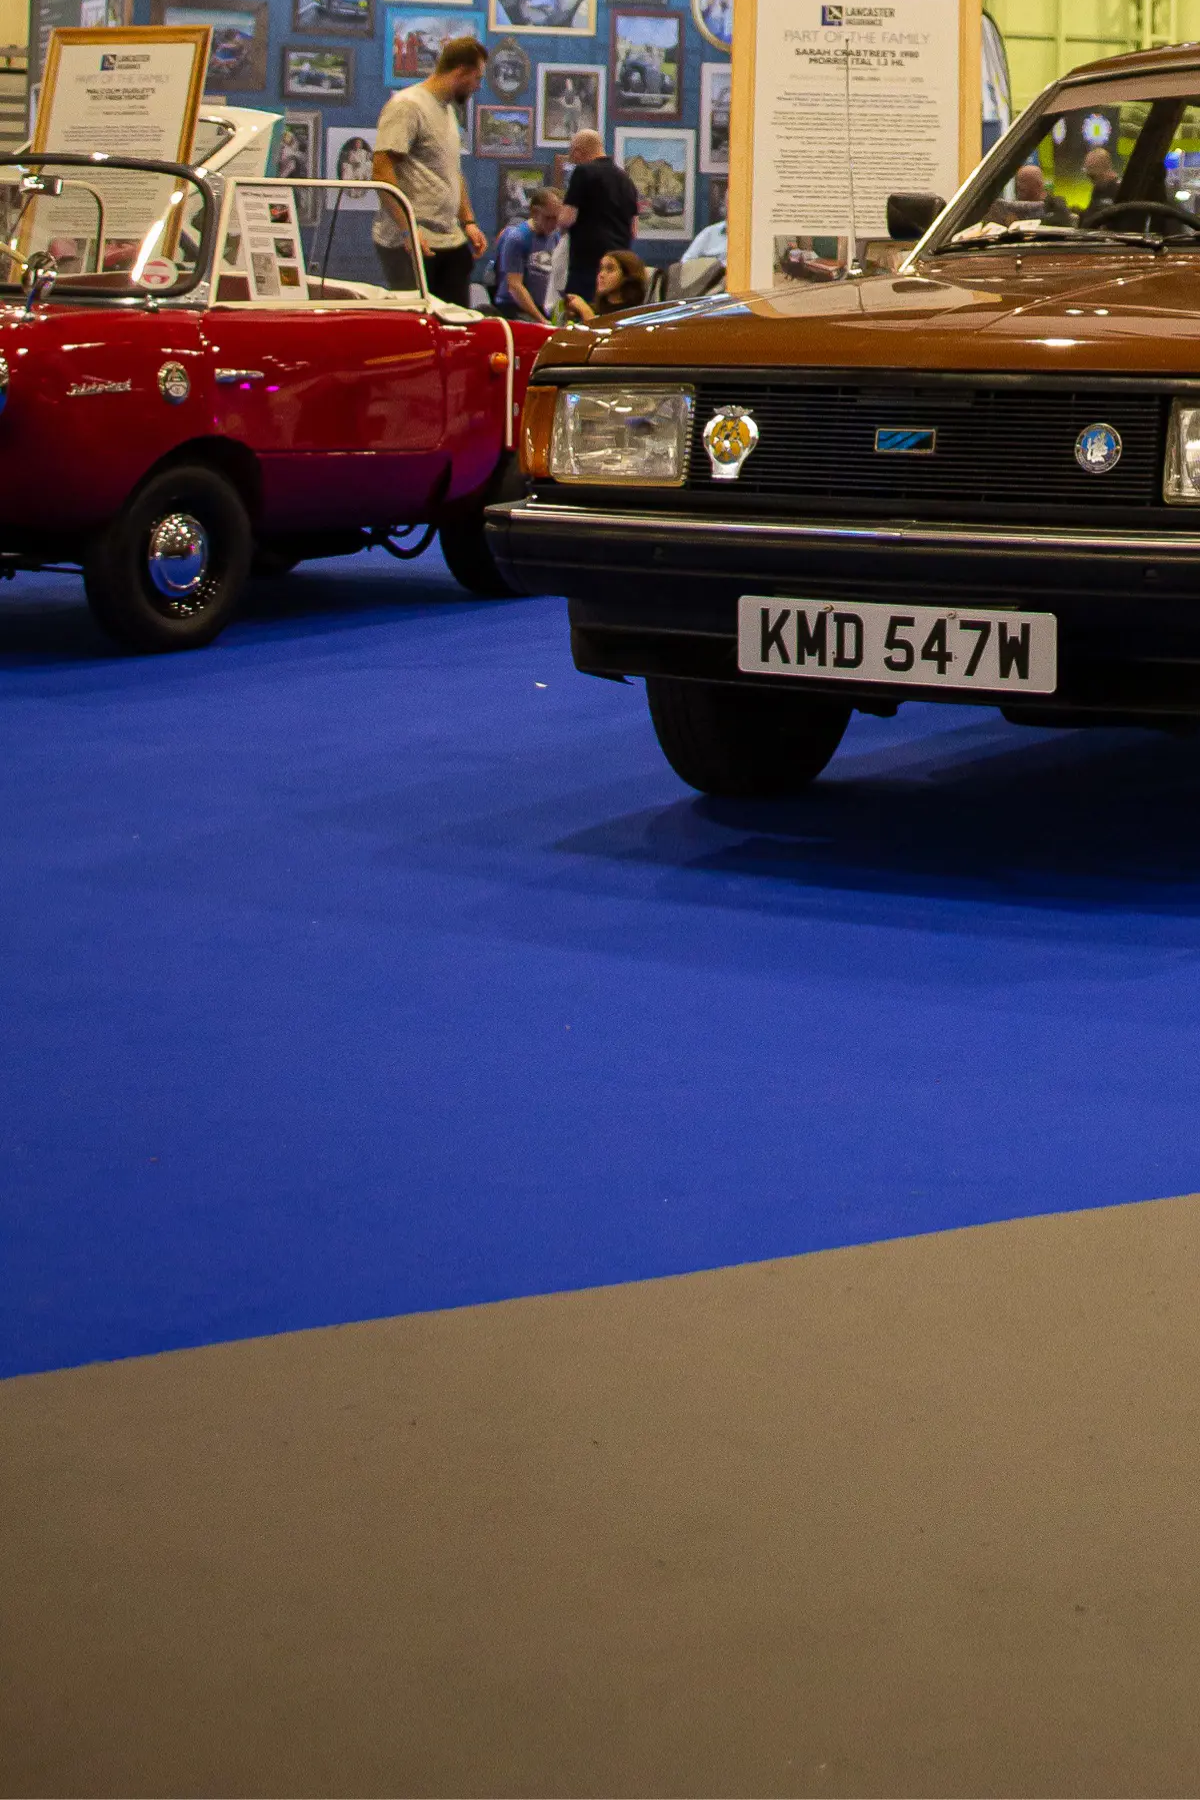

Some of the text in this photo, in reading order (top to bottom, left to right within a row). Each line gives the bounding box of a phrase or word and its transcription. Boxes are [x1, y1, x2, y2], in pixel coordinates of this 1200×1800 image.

[845, 6, 896, 18] LANCASTER
[784, 30, 931, 45] PART OF THE FAMILY
[795, 48, 831, 57] SARAH
[808, 57, 848, 66] MORRIS
[851, 58, 873, 66] ITAL
[759, 606, 1032, 681] KMD 547W
